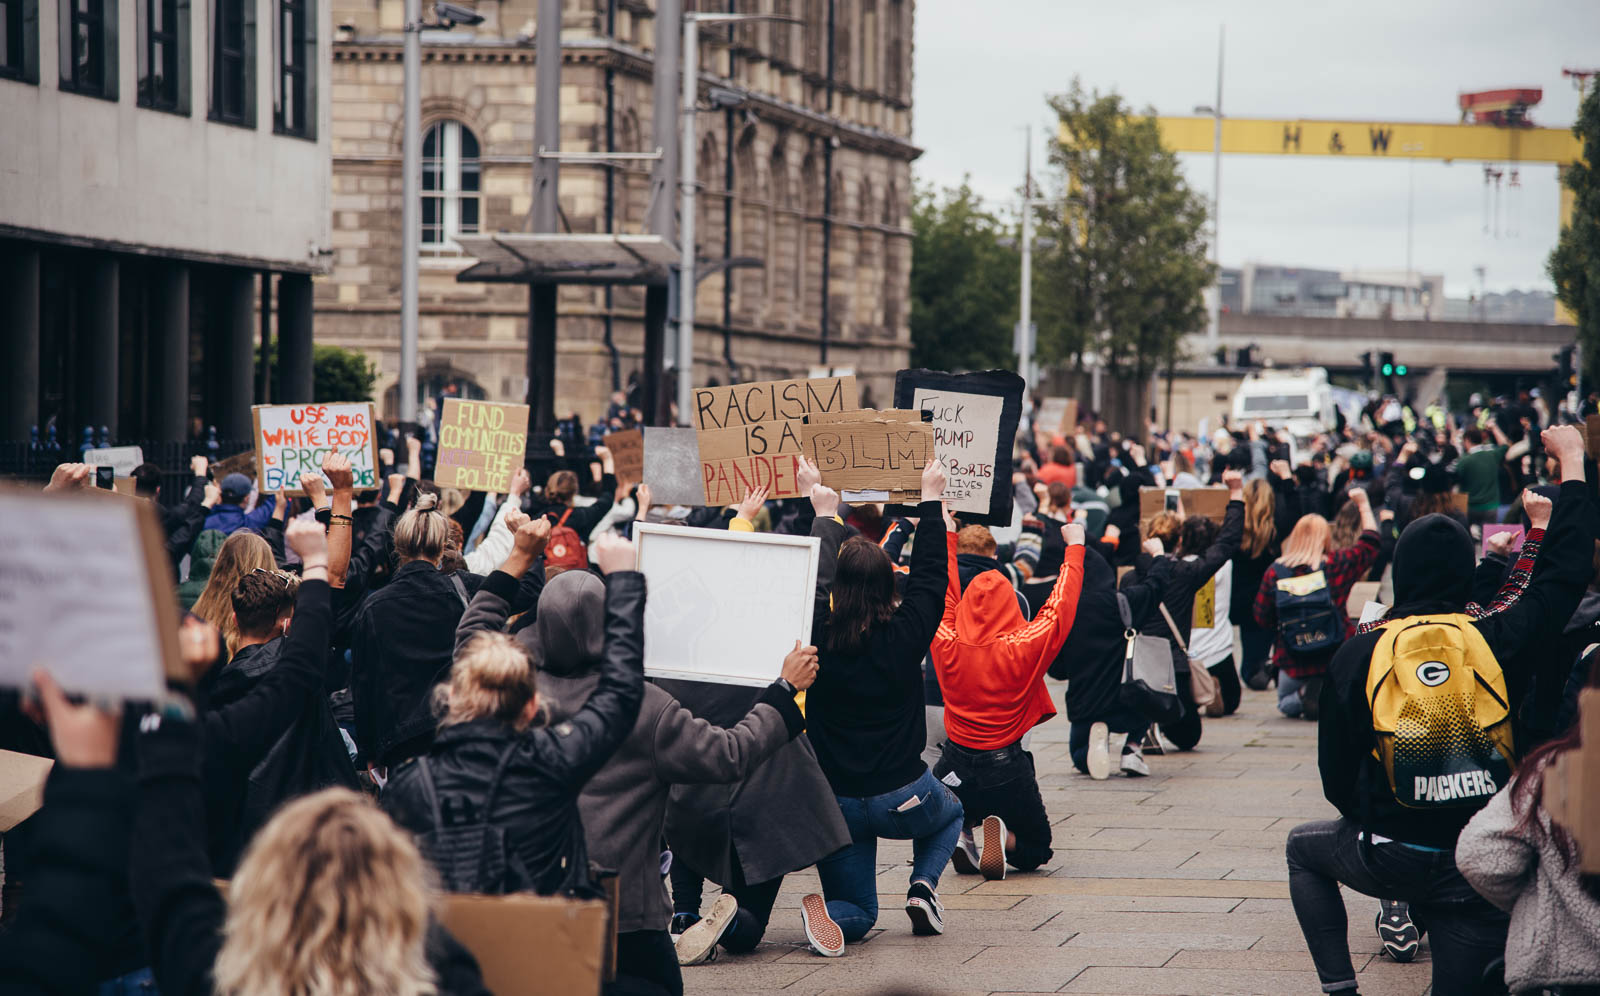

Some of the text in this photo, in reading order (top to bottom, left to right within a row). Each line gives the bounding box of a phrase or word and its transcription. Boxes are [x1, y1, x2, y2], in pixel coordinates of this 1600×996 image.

[1368, 127, 1393, 154] W
[290, 405, 328, 425] USE
[457, 402, 504, 431] FUND
[696, 378, 843, 430] RACISM
[262, 426, 369, 448] WHITE BODY
[441, 424, 524, 456] COMMUNITIES
[745, 421, 802, 456] IS A
[932, 427, 974, 448] RUMP
[481, 451, 512, 474] THE
[812, 431, 927, 472] BLM
[455, 466, 509, 491] POLICE
[949, 478, 982, 490] LIVES
[1416, 660, 1450, 687] G
[1414, 769, 1498, 802] PACKERS
